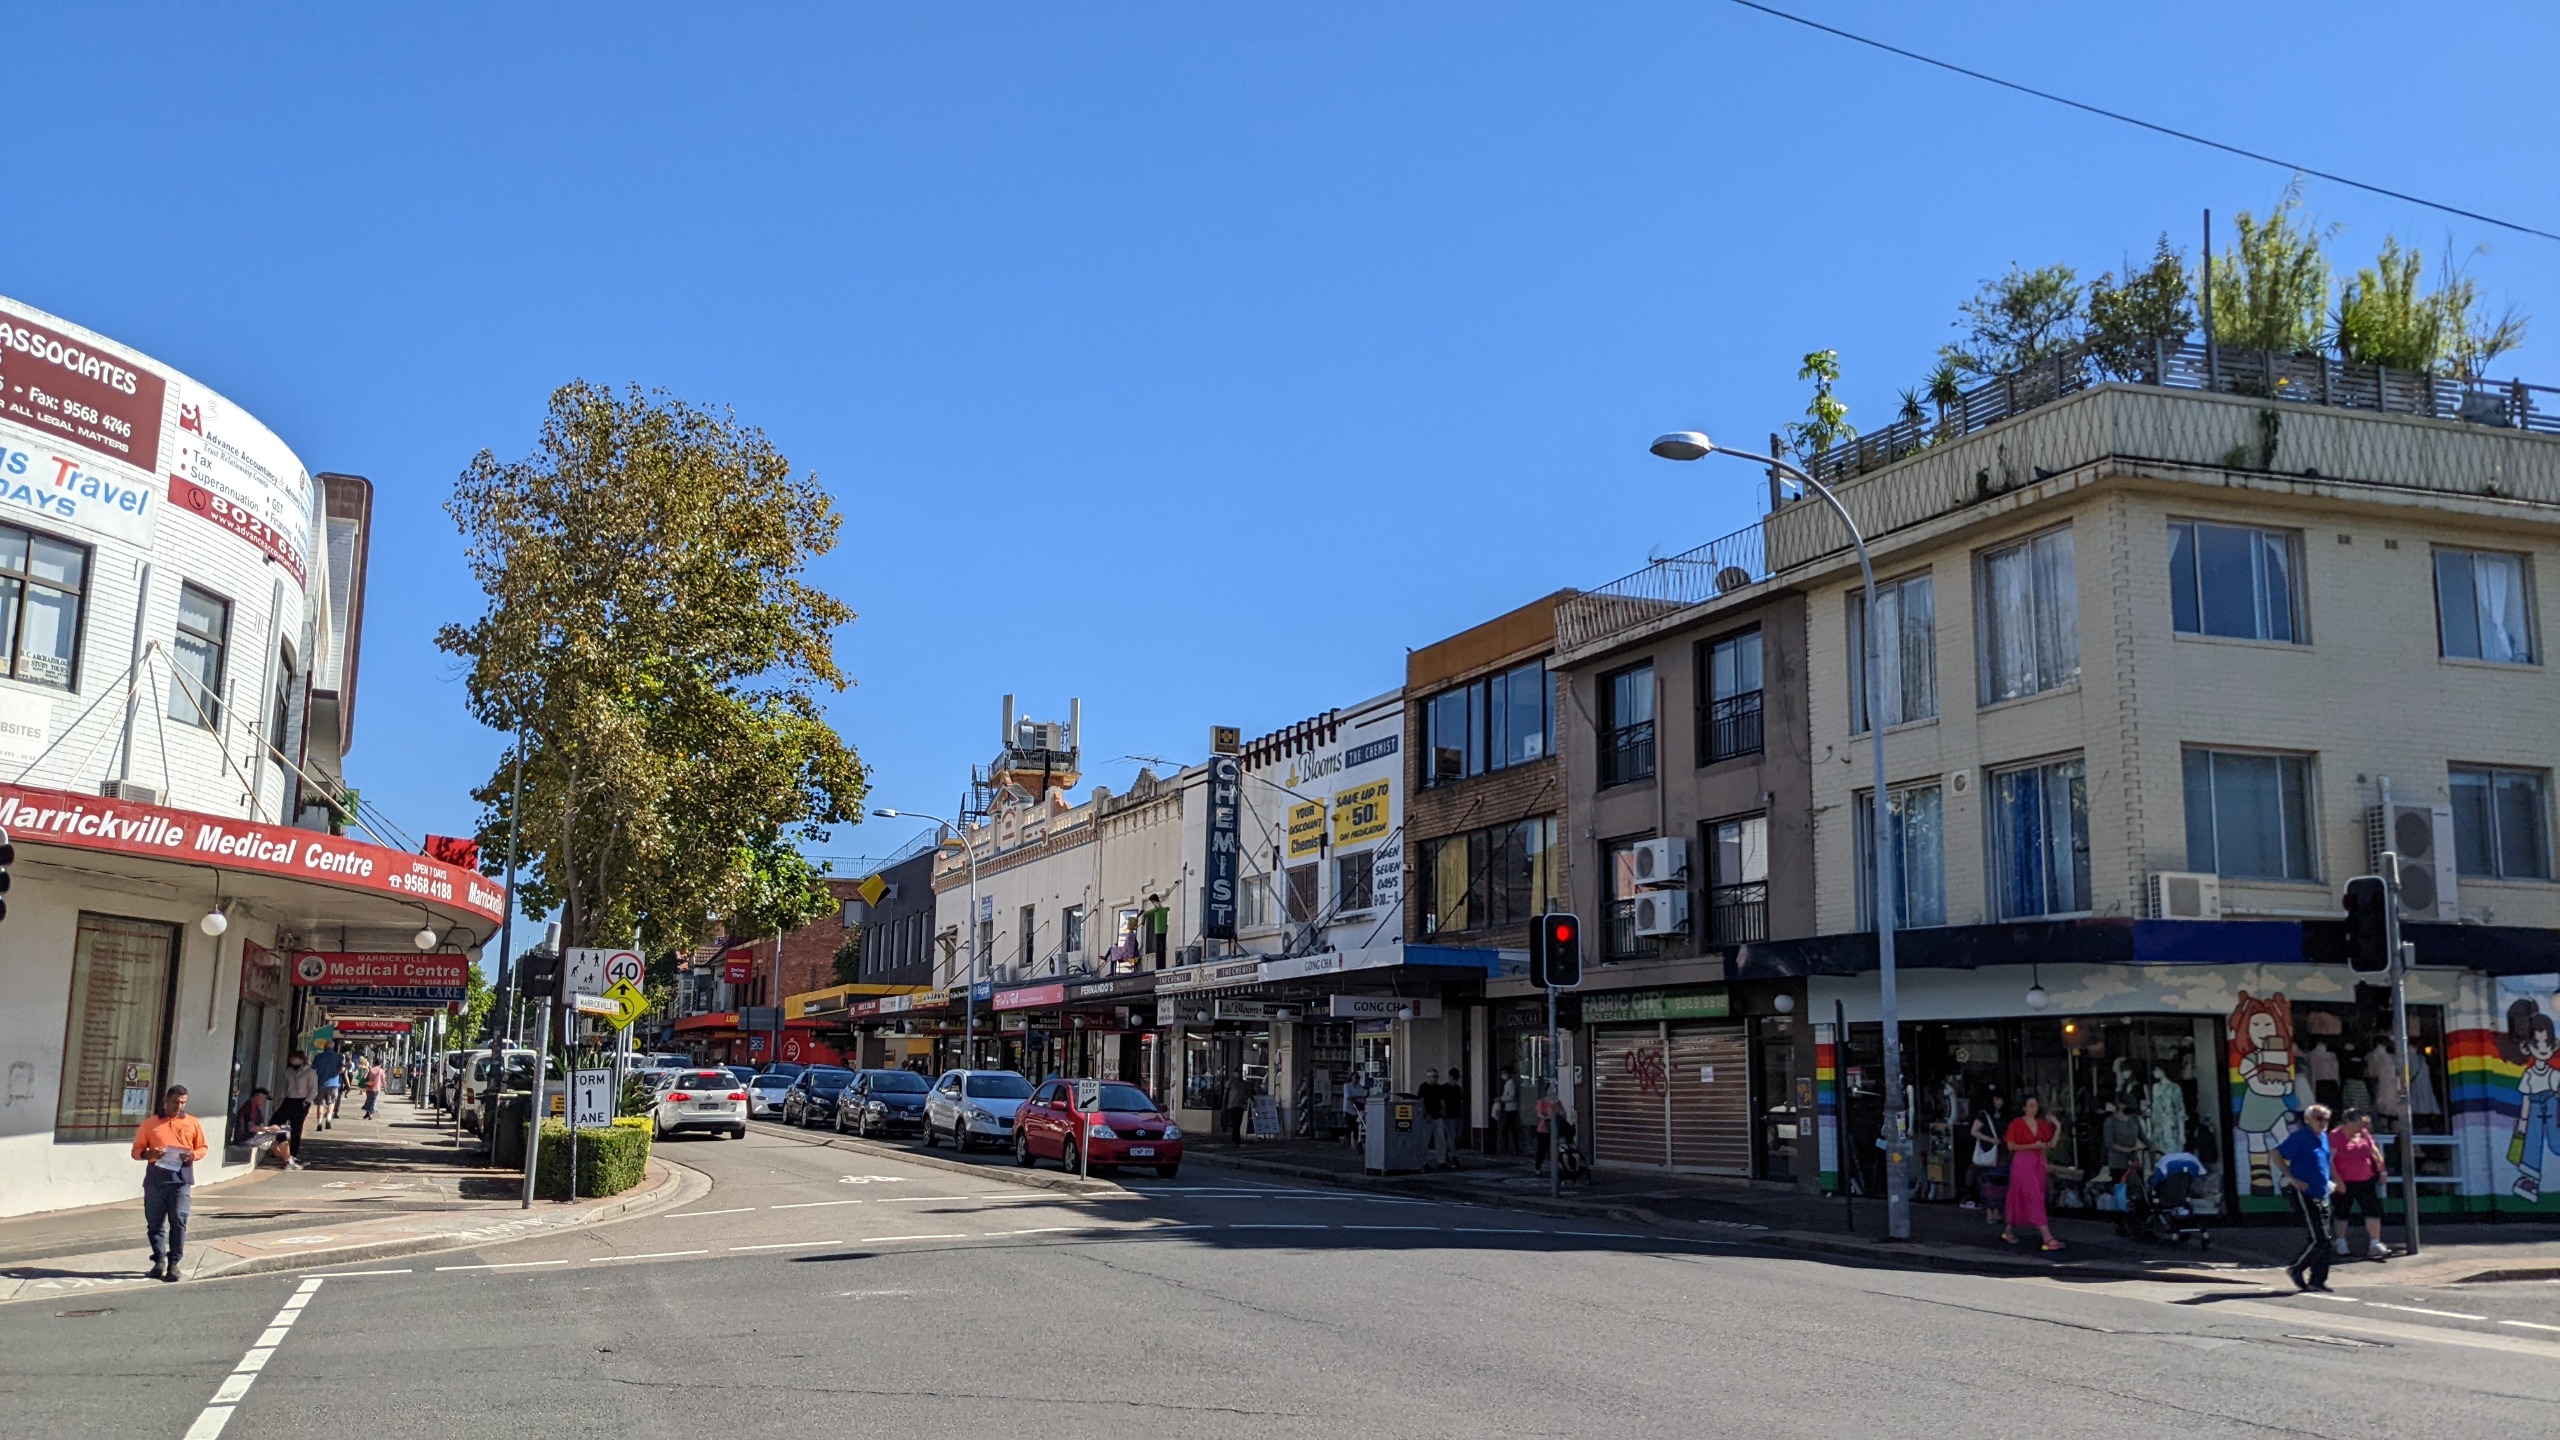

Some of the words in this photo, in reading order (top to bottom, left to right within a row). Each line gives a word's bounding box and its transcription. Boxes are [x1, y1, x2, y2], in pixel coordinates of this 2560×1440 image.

[0, 323, 137, 394] ASSOCIATES
[29, 386, 59, 410] Fax:
[63, 400, 98, 424] 9568
[102, 414, 132, 438] 4746
[10, 403, 34, 418] ALL
[37, 412, 75, 433] LEGAL
[78, 426, 129, 453] MATTERS
[193, 449, 213, 471] Tax
[206, 431, 239, 457] Advance
[241, 451, 278, 486] Accountancy
[52, 456, 149, 516] Travel
[190, 466, 259, 513] Superannuation
[272, 498, 284, 516] GST
[210, 496, 273, 543] 8021
[270, 512, 293, 543] Financing
[31, 660, 48, 670] STUDY
[51, 664, 68, 674] TOURS
[1298, 748, 1342, 784] Blooms
[1348, 752, 1361, 765] THE
[1364, 738, 1396, 759] CHEMIST
[1336, 791, 1360, 808] SAVE
[1361, 787, 1375, 801] UP
[1377, 783, 1389, 797] TO
[1295, 805, 1315, 820] YOUR
[1288, 817, 1323, 835] DISCOUNT
[1339, 831, 1349, 842] ON
[1350, 822, 1387, 839] MEDICATION
[194, 824, 297, 865] Medical
[304, 843, 374, 878] Centre
[1211, 758, 1236, 926] CHEMIST
[1291, 834, 1319, 854] Chemis
[1377, 845, 1400, 860] OPEN
[412, 861, 429, 877] OPEN
[429, 866, 433, 876] 7
[433, 869, 447, 880] DAYS
[1375, 861, 1401, 876] SEVEN
[404, 873, 429, 895] 9568
[430, 880, 452, 900] 4188
[1377, 876, 1399, 889] DAYS
[357, 954, 429, 963] MARRICKVILLE
[1304, 959, 1320, 972] GONG
[1321, 958, 1333, 969] CHA
[330, 963, 398, 976] Medical
[404, 963, 460, 977] Centre
[611, 962, 638, 980] 40
[1232, 963, 1255, 975] CHEMIST
[368, 986, 421, 997] DENTAL
[425, 986, 461, 999] CARE
[1080, 982, 1114, 996] FERNANDO'S
[580, 998, 613, 1011] MARRICKVILLE
[1232, 1002, 1262, 1014] Blooms
[1354, 1002, 1384, 1012] GONG
[1387, 1003, 1402, 1013] CH
[1582, 993, 1629, 1013] FABRIC
[1631, 991, 1665, 1010] CITY
[1584, 1010, 1628, 1022] WHOLESALE
[1637, 1008, 1664, 1020] RETAIL
[575, 1074, 605, 1086] ORM
[585, 1089, 592, 1109] 1
[576, 1112, 605, 1124] ANE
